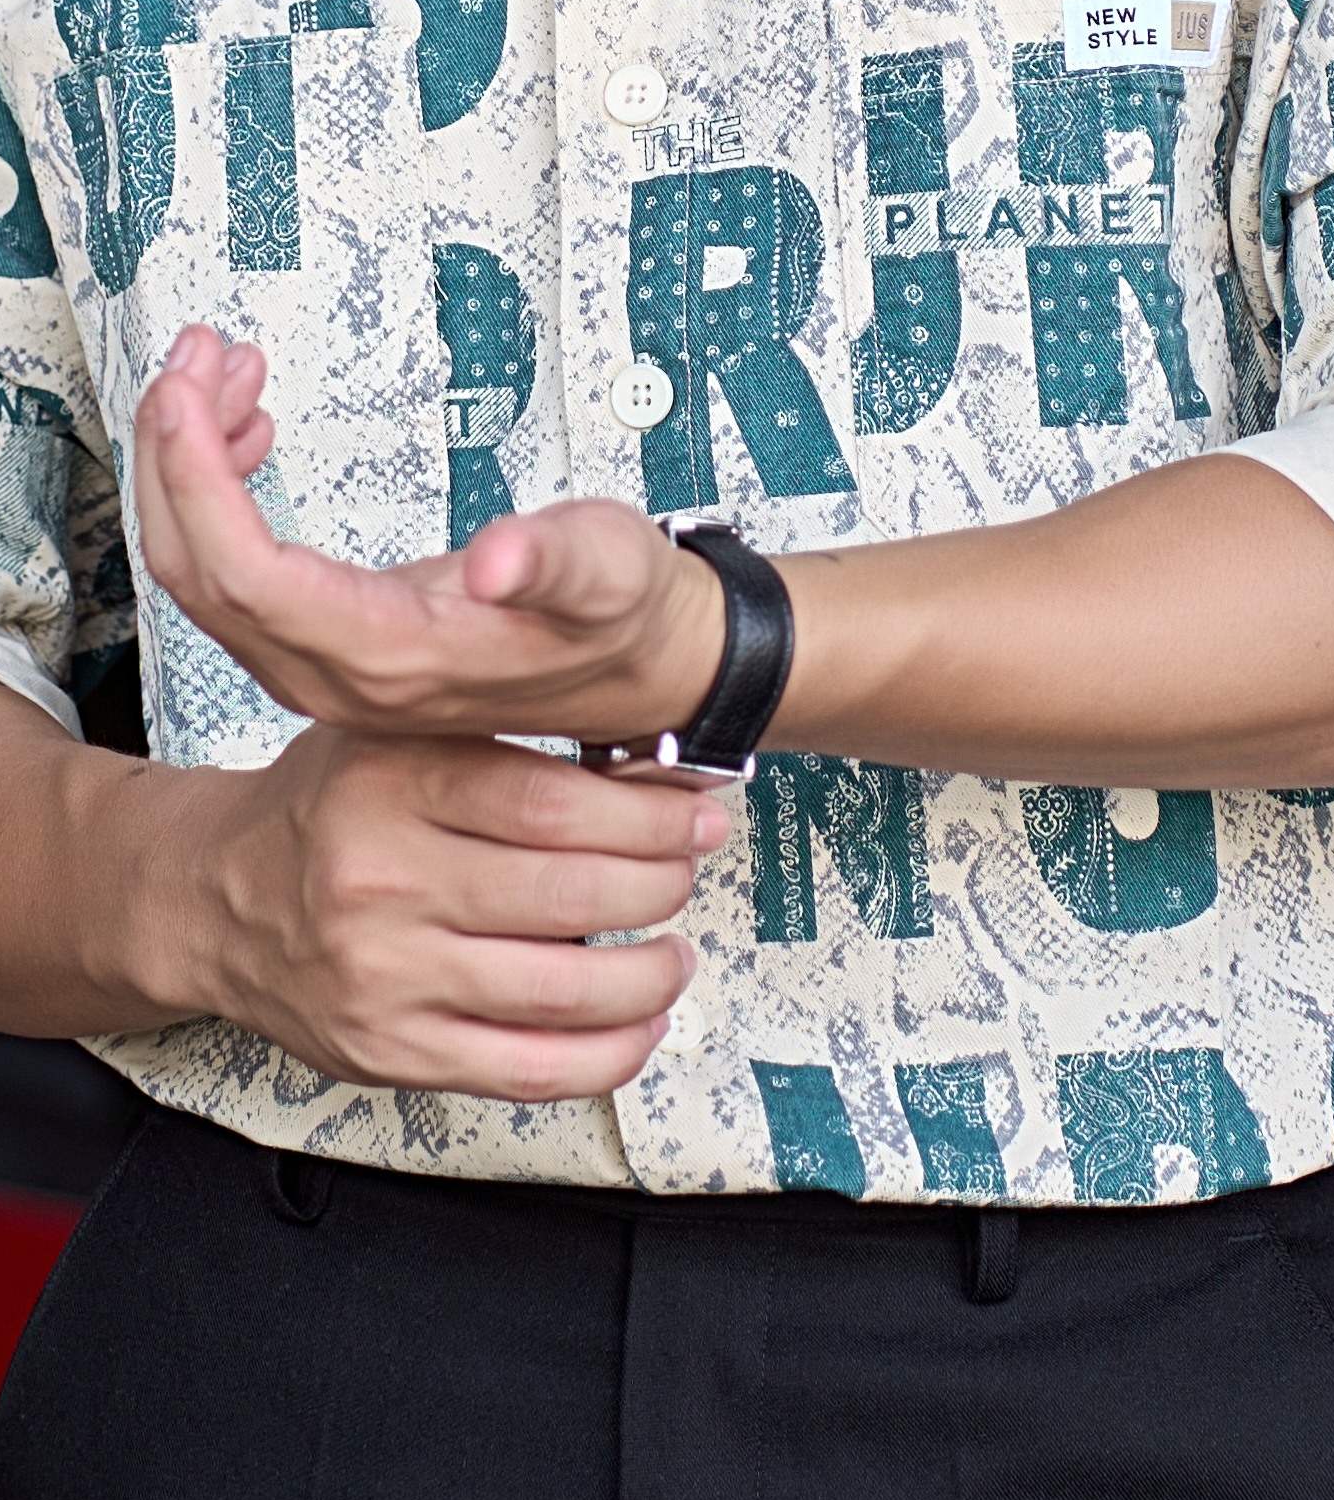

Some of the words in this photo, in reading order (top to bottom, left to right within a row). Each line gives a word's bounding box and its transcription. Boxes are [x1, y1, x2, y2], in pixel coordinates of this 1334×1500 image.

[1086, 7, 1137, 27] NEW
[1176, 11, 1209, 41] JUS
[1088, 28, 1158, 50] STYLE
[632, 115, 745, 171] THE
